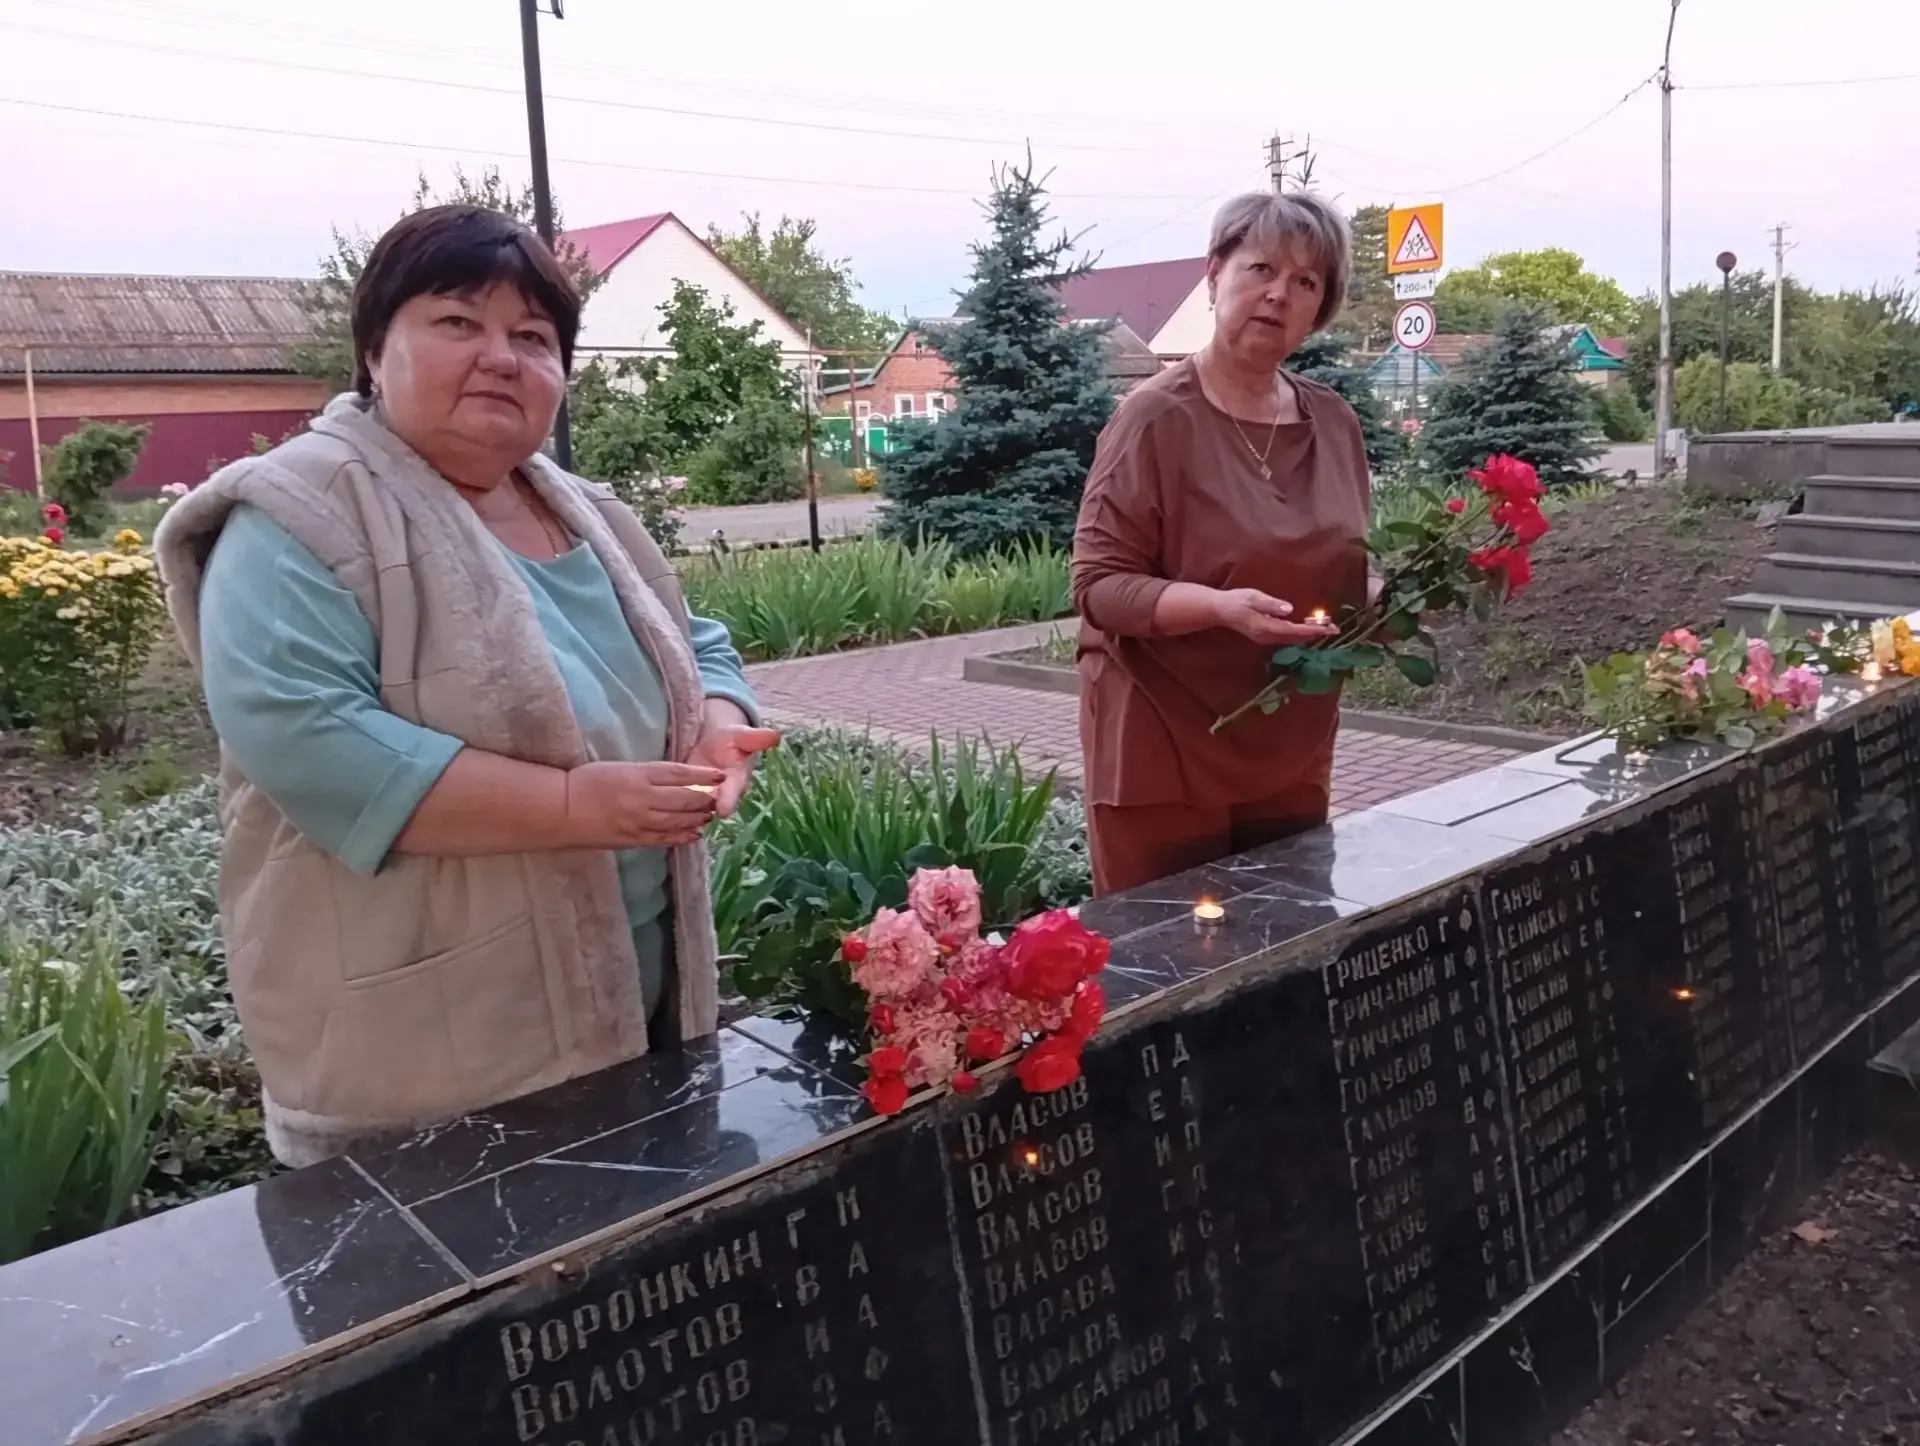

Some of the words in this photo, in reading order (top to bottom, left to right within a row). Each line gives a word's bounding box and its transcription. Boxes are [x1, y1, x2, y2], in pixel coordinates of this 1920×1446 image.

[1403, 316, 1425, 335] 20
[1321, 924, 1430, 996] ГРИЦЕНКО
[1437, 916, 1450, 944] Г
[961, 1075, 1091, 1161] ВЛАСОВ
[1140, 1043, 1160, 1078] П
[1148, 1088, 1167, 1123] Е
[500, 1230, 763, 1382] ВОРОНКИН
[786, 1206, 807, 1250] Г
[796, 1263, 821, 1308] В
[847, 1240, 870, 1280] А
[857, 1292, 879, 1332] А
